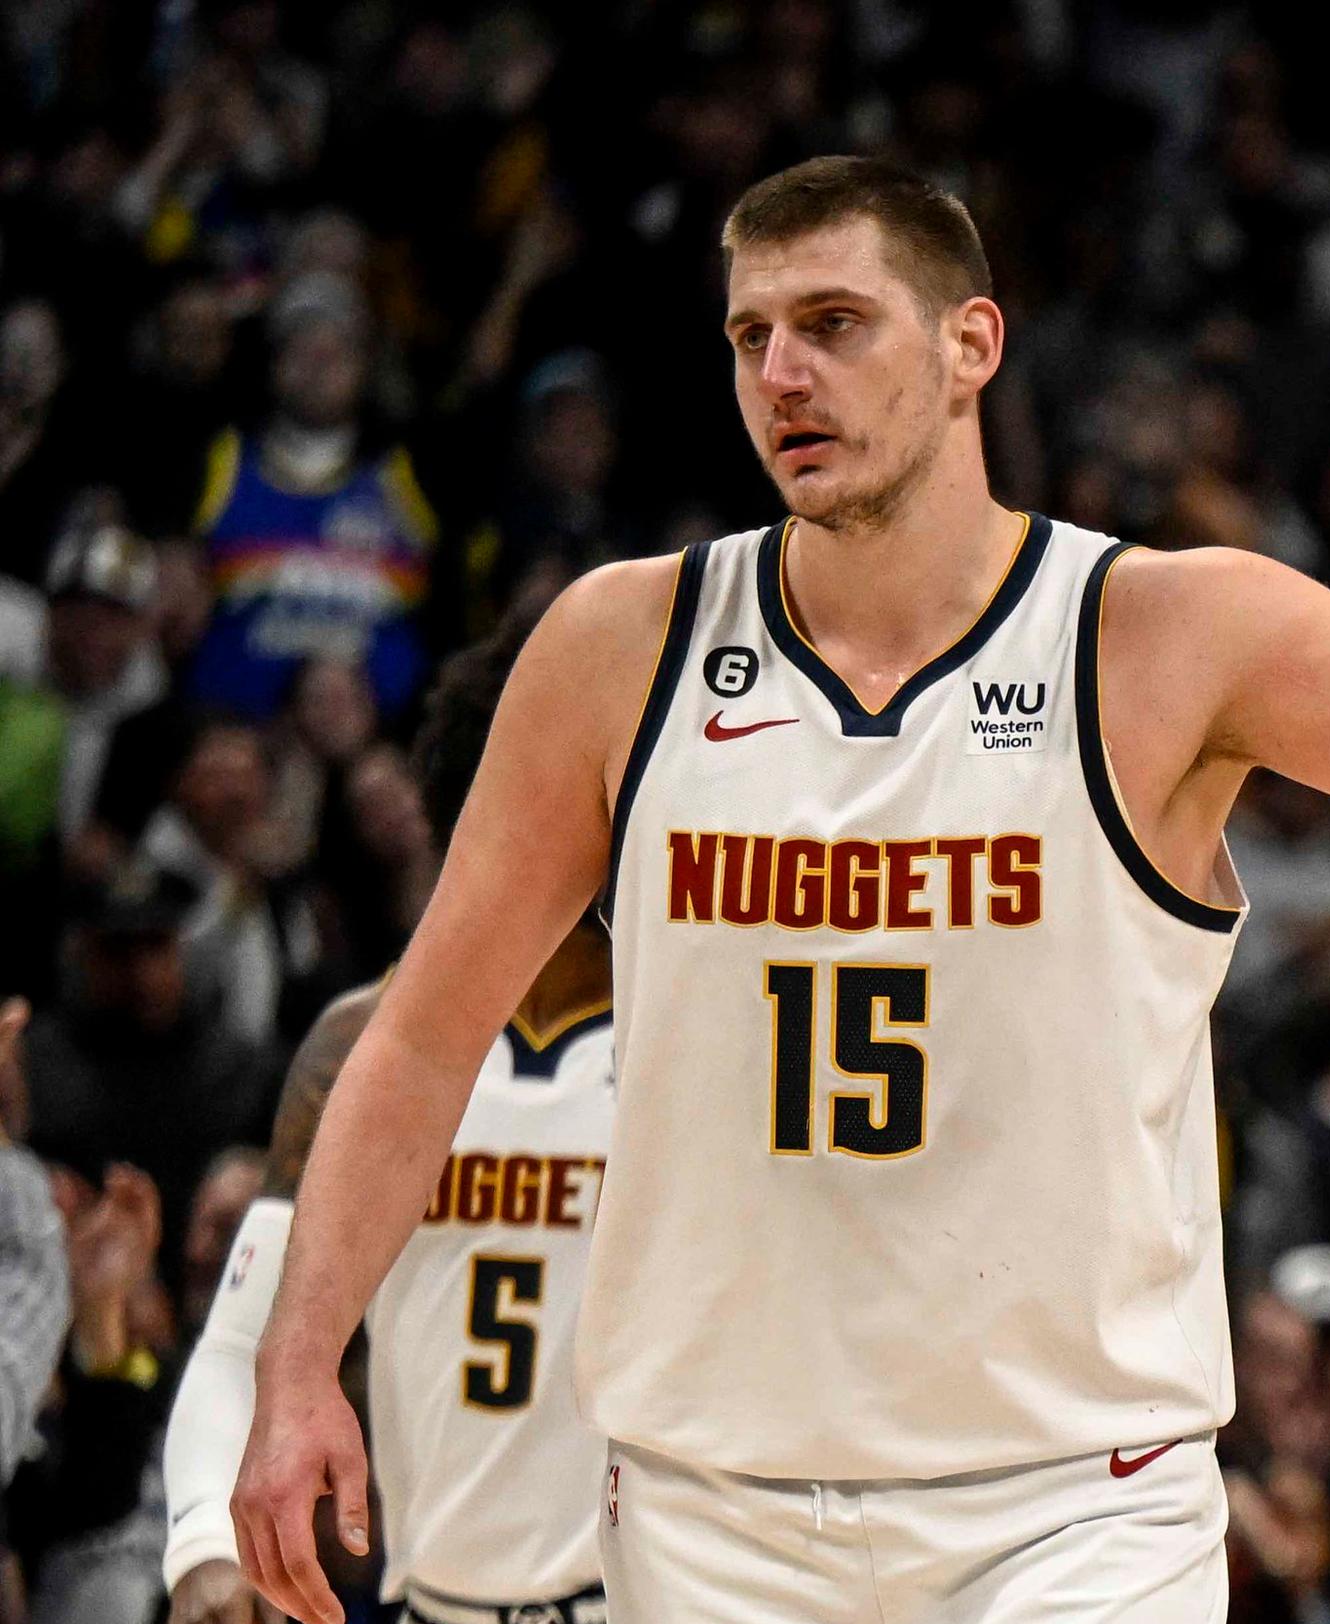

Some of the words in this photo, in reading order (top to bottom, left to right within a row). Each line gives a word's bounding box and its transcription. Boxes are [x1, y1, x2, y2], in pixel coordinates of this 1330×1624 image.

[714, 653, 750, 692] 6
[972, 681, 1046, 716] WU
[970, 719, 1044, 735] Western
[982, 734, 1032, 750] Union
[667, 830, 1044, 934] NUGGETS
[763, 960, 931, 1160] 15
[461, 1252, 553, 1417] 5
